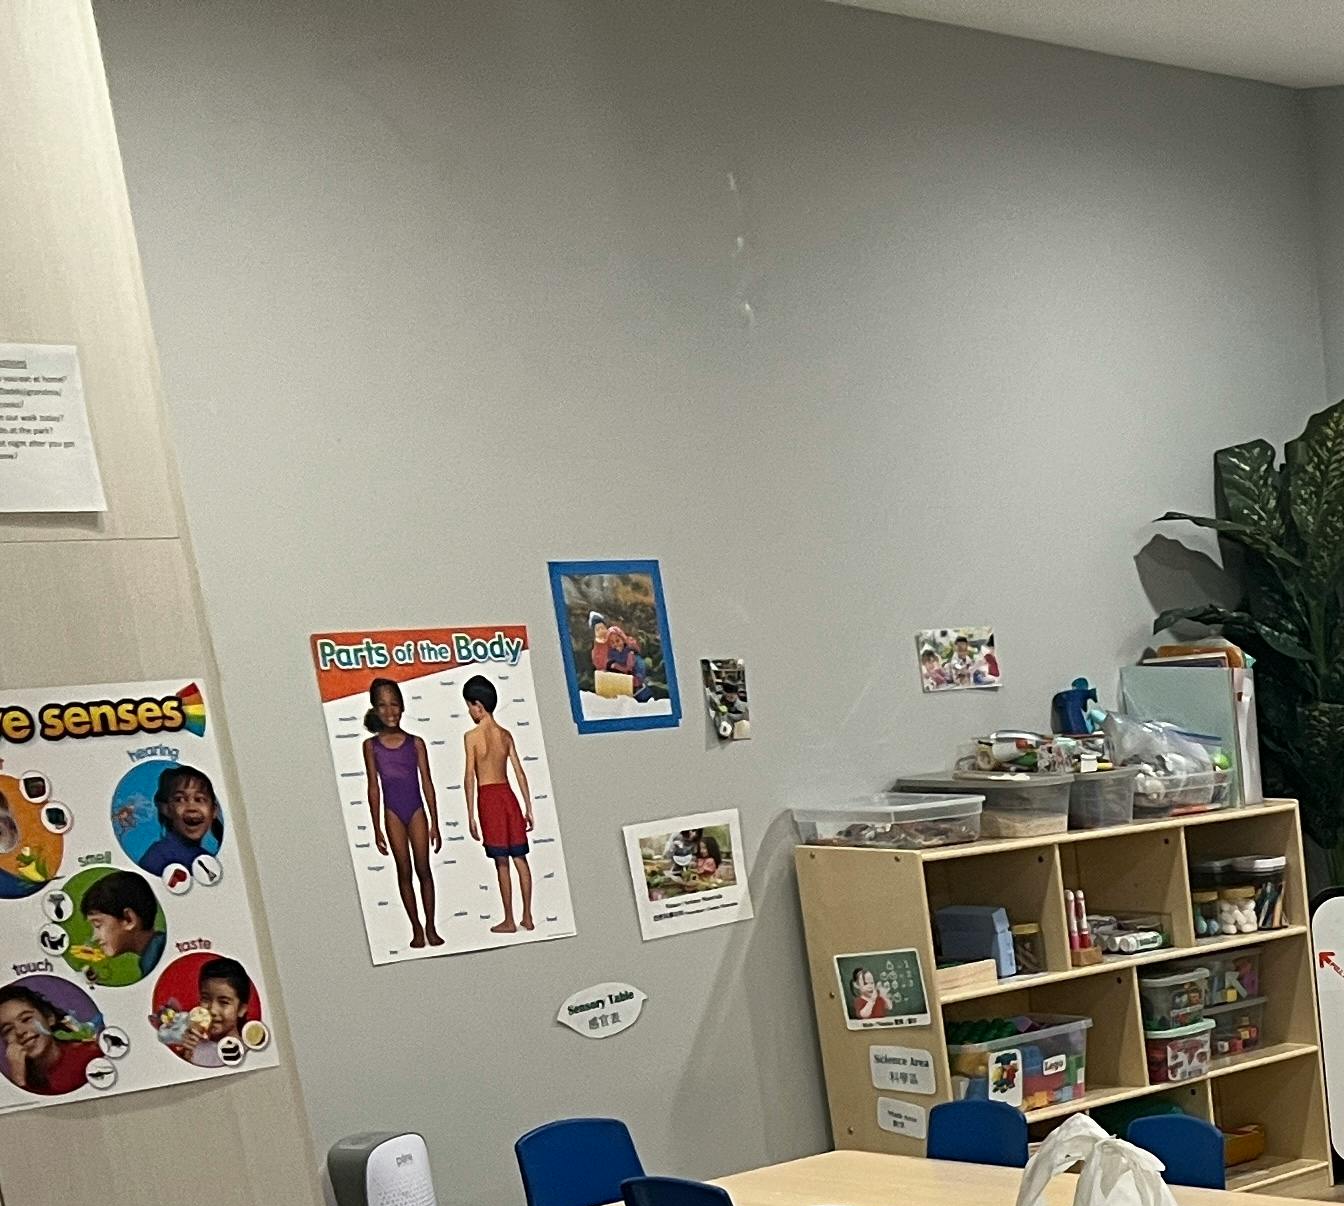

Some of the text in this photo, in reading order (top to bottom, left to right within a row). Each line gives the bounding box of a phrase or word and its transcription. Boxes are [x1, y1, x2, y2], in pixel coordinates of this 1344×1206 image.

[318, 631, 523, 668] Parts of the Body
[41, 698, 185, 740] senses
[127, 743, 180, 763] hearing
[77, 851, 112, 867] smell
[175, 938, 212, 953] taste
[12, 959, 54, 976] touch
[568, 991, 634, 1016] Sensory Table
[874, 1054, 929, 1068] Science Area
[1044, 1057, 1064, 1073] Lego
